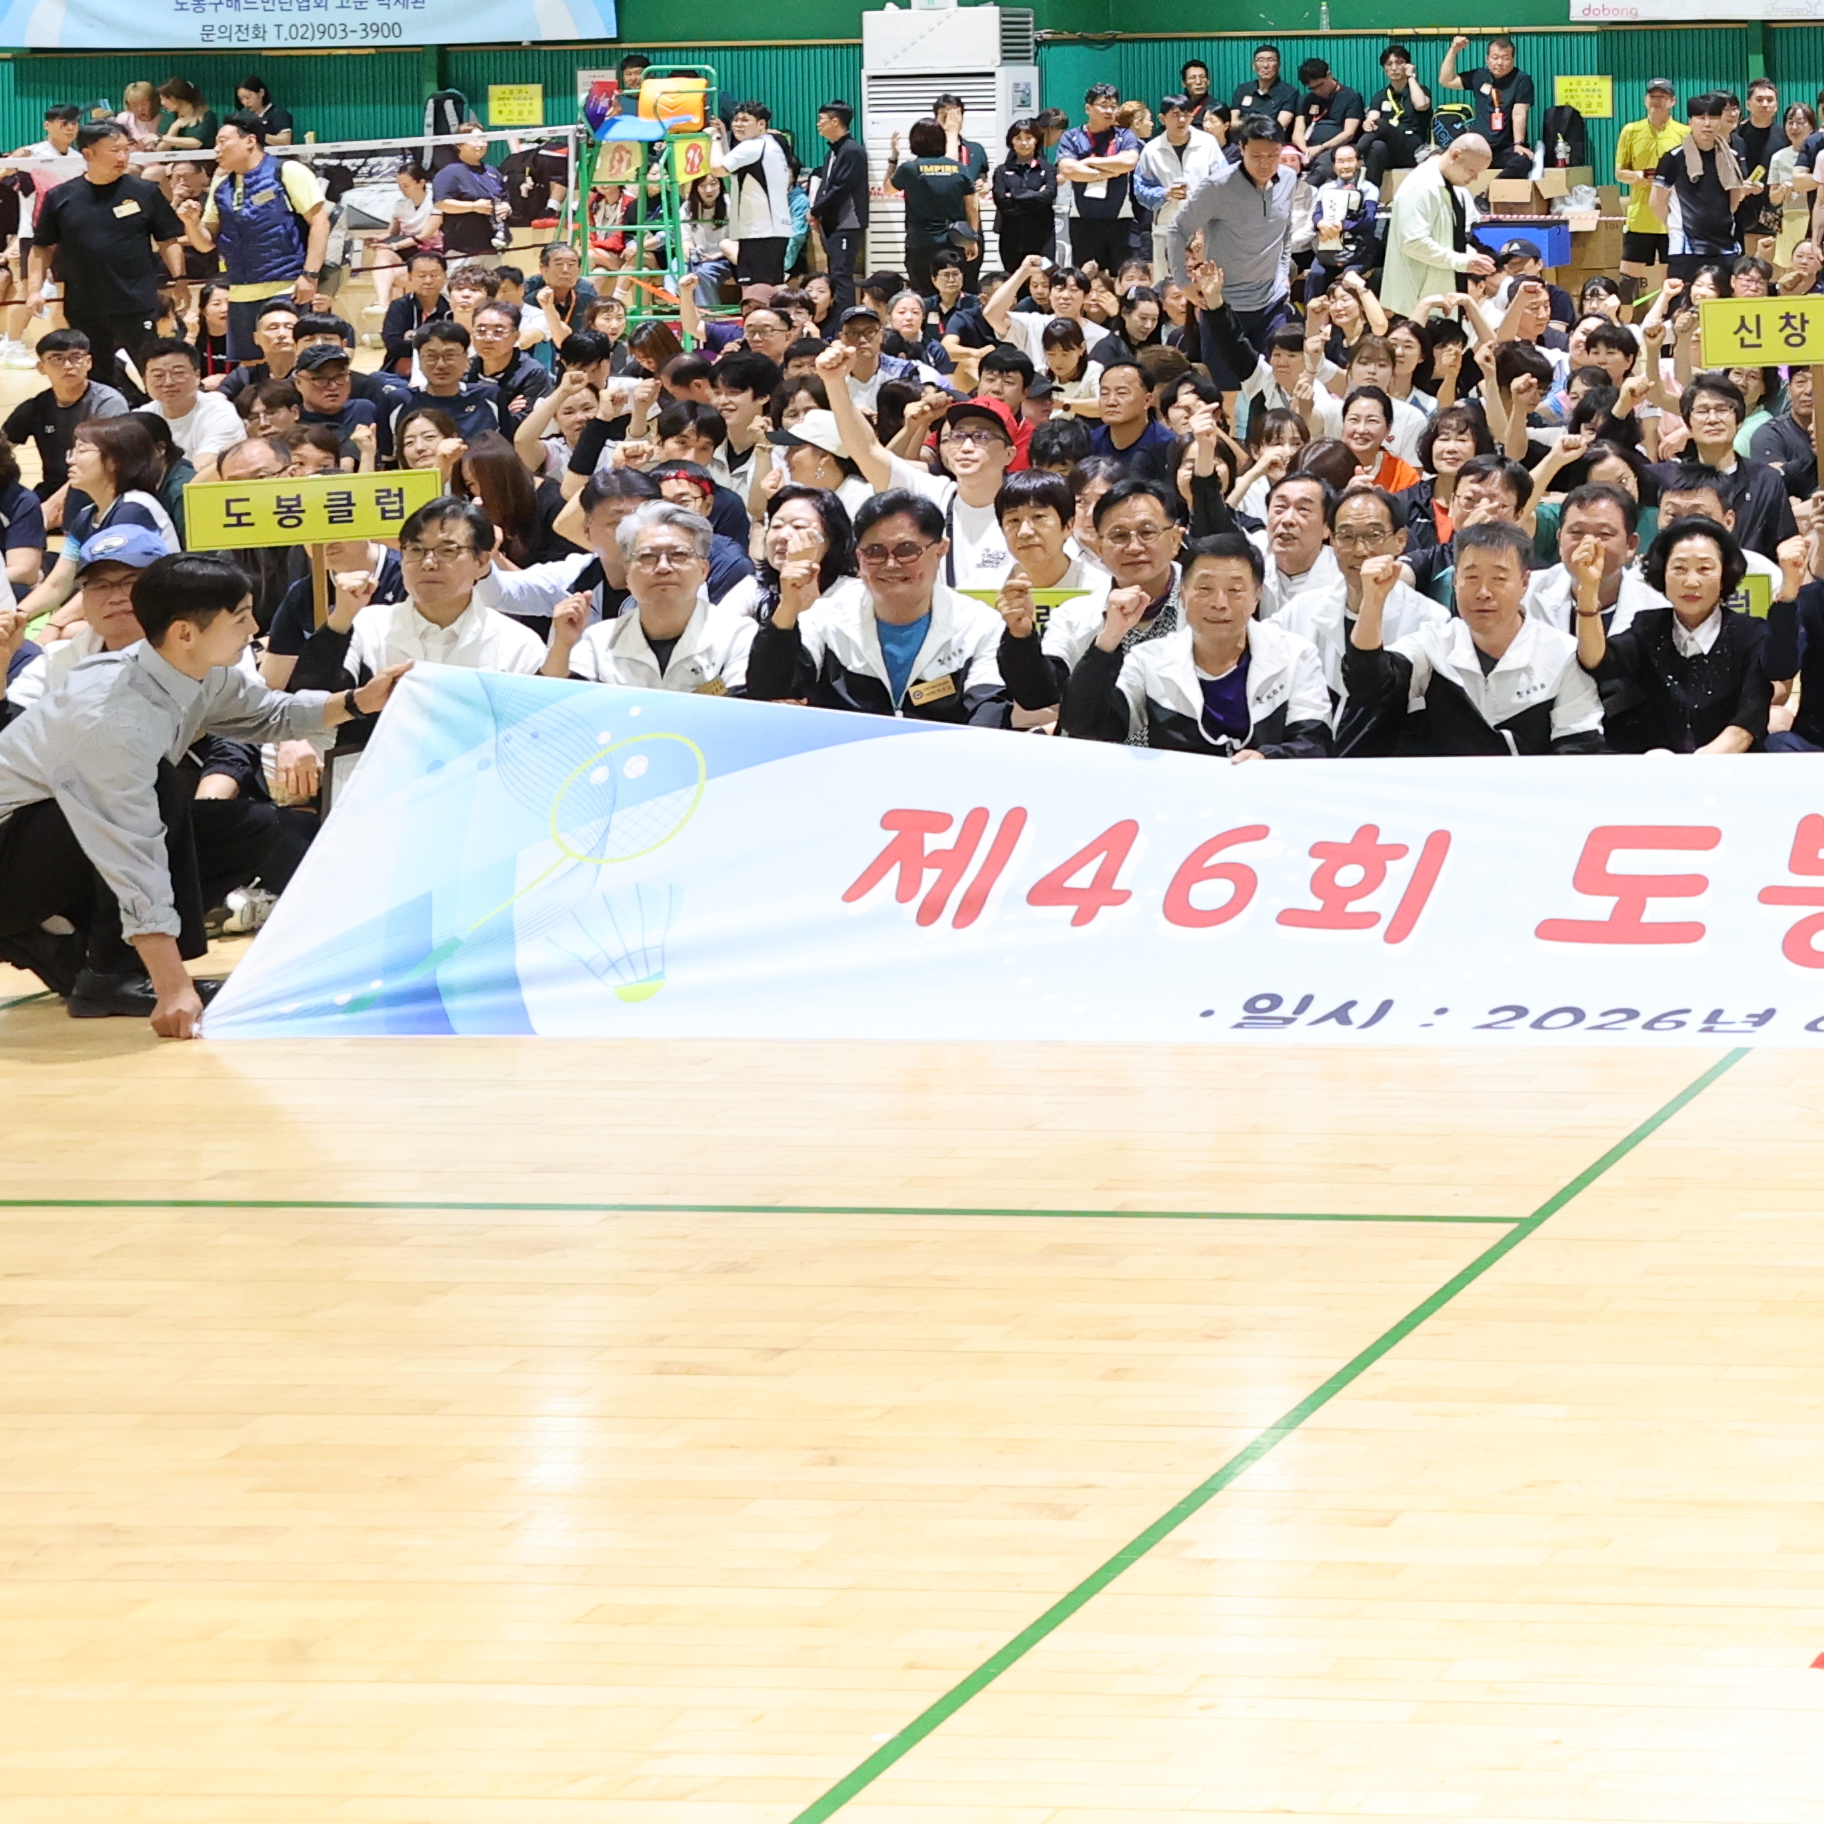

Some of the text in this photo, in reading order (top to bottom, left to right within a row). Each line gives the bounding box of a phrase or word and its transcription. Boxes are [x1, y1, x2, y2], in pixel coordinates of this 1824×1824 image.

[1582, 3, 1639, 19] dobong
[199, 21, 403, 43] 문의전화 T.02)903-3900
[223, 487, 406, 529] 도봉클럽
[842, 806, 1452, 945] 제46회
[1473, 1005, 1777, 1034] 2026년
